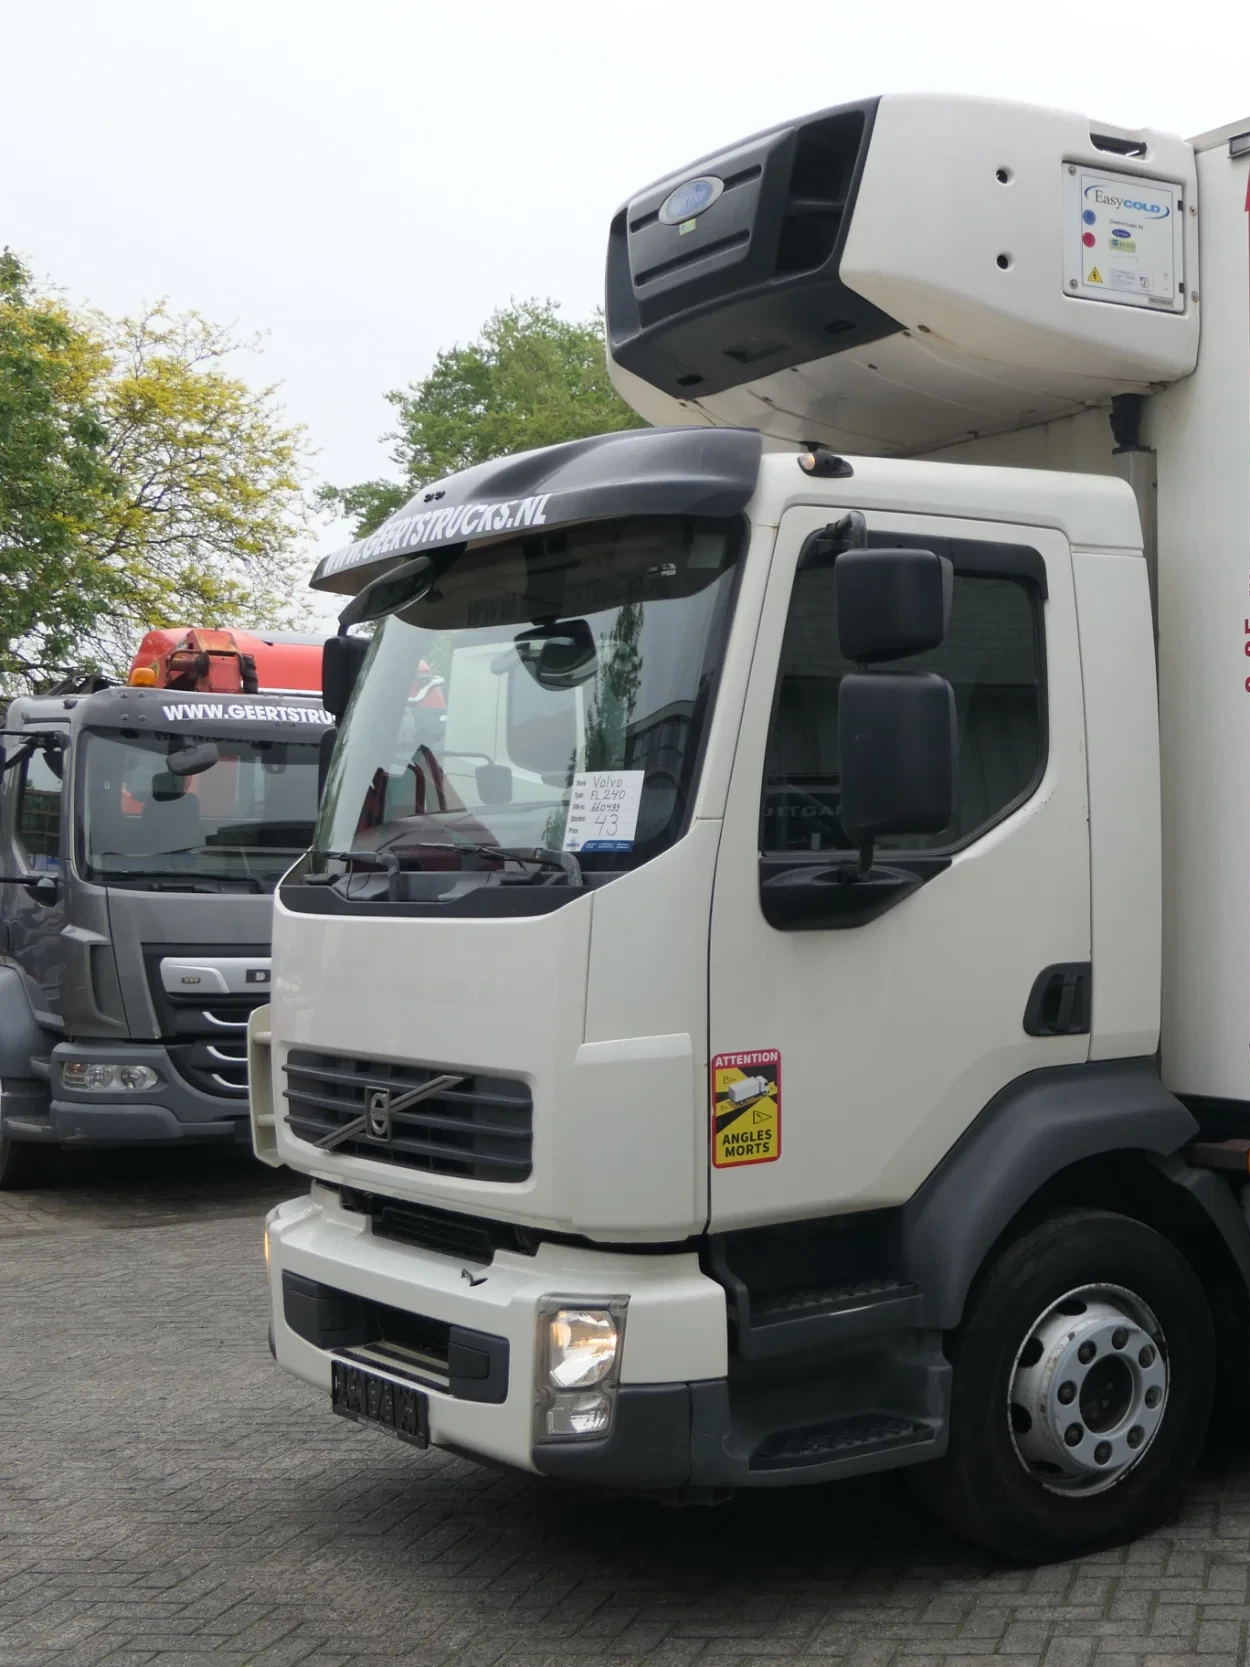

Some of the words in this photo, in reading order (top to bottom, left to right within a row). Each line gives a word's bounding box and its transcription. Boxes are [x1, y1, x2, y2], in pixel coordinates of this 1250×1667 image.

[1094, 189, 1161, 213] EasyCOLD
[322, 494, 552, 575] WWW.GEERTSTRUCKS.NL
[594, 776, 622, 788] Volvo
[603, 789, 626, 800] 240
[595, 814, 619, 836] 43
[715, 1051, 778, 1067] ATTENTION
[722, 1129, 772, 1145] ANGLES
[725, 1142, 770, 1157] MORTS
